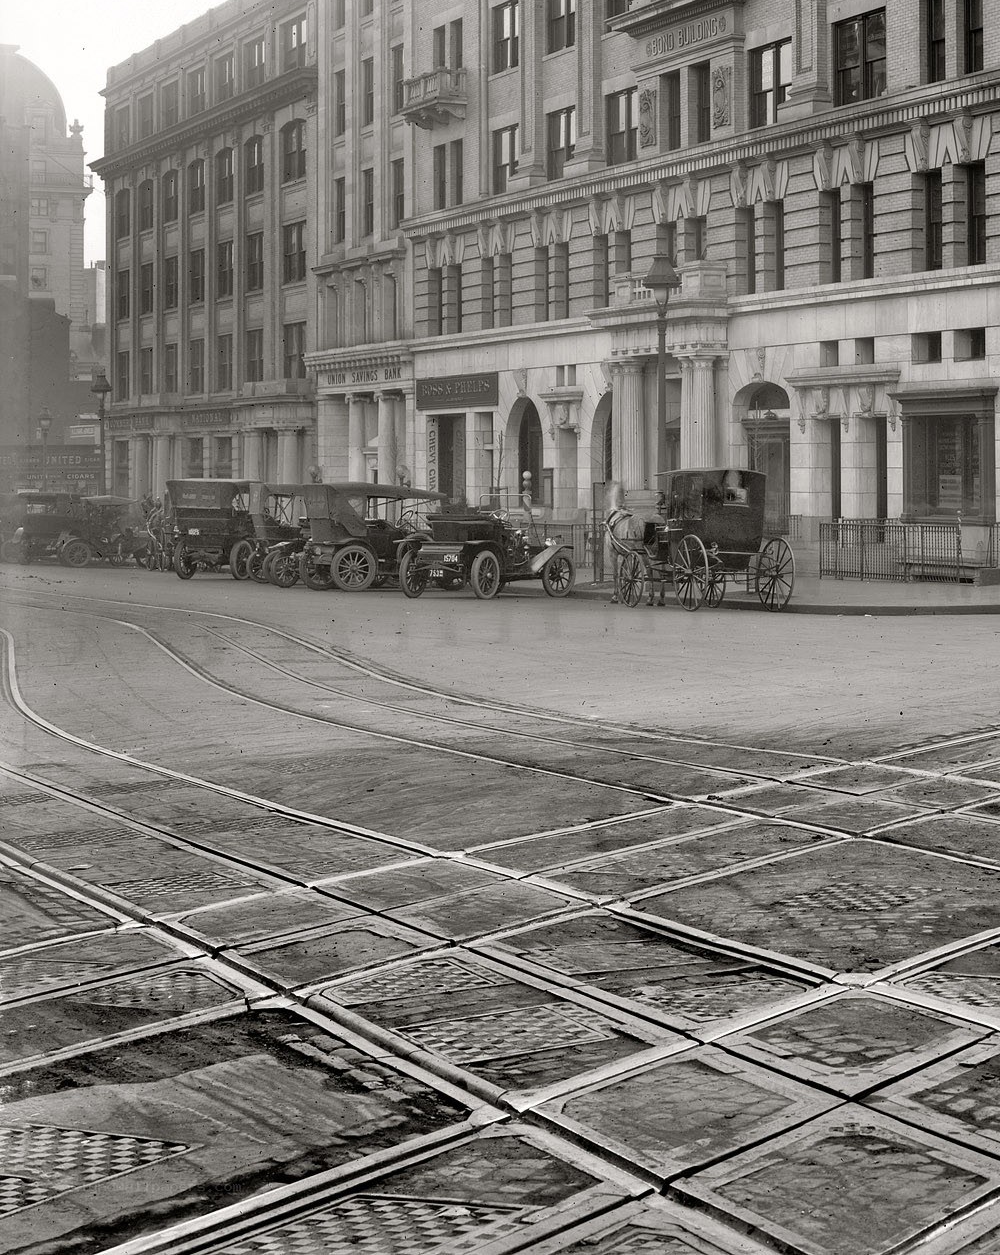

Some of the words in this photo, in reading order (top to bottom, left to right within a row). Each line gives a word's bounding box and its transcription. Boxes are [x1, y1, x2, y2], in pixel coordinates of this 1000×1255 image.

[651, 32, 675, 56] BOND
[678, 17, 718, 47] BUILDING
[327, 373, 346, 385] UNION
[351, 369, 378, 383] SAVINGS
[384, 366, 402, 380] BANK
[445, 383, 452, 395] &
[454, 379, 490, 394] PHELPS
[428, 430, 436, 464] CHEVY
[428, 468, 437, 506] CHAE
